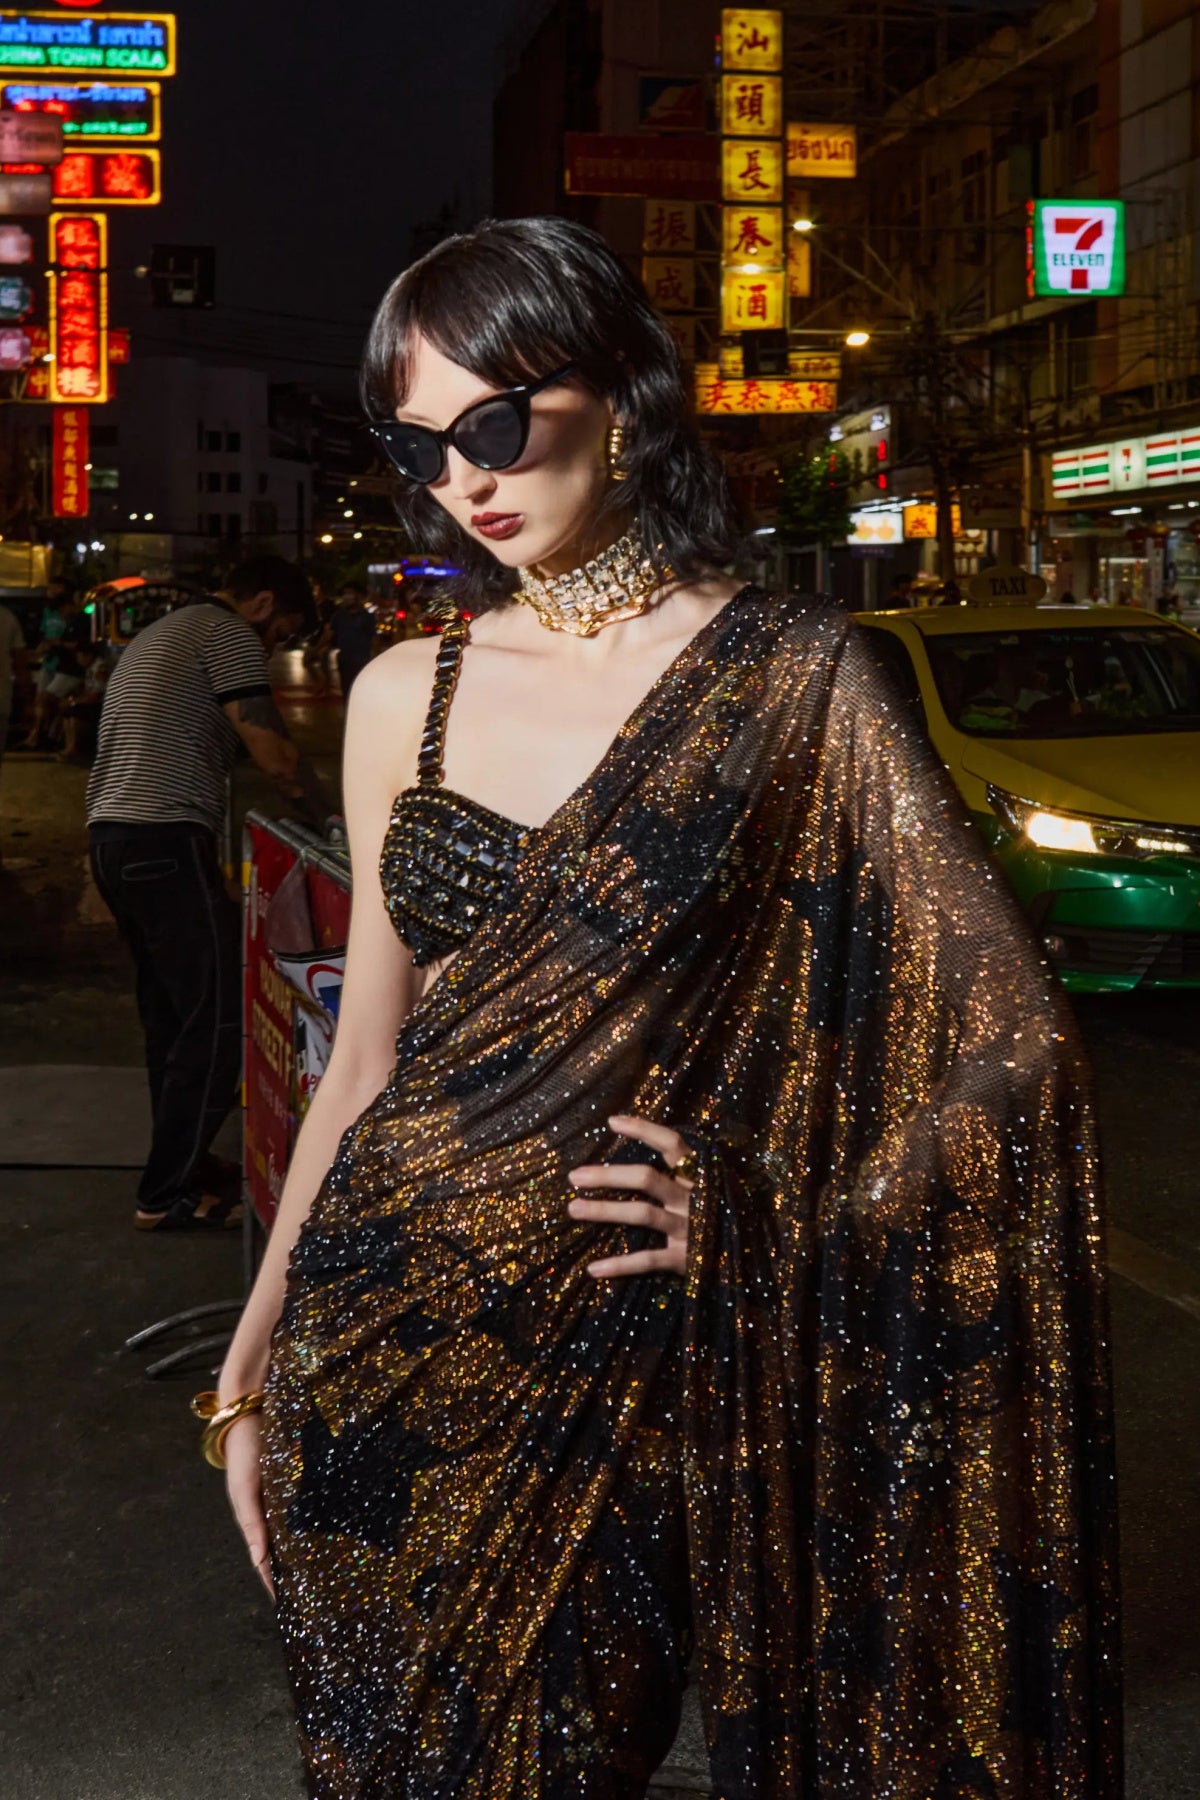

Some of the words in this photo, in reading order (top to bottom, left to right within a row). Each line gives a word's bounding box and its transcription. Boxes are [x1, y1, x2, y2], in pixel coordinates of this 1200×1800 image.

[47, 47, 104, 67] TOWN
[105, 48, 167, 69] SCALA
[1055, 217, 1104, 251] 7
[988, 575, 1027, 597] TAXI
